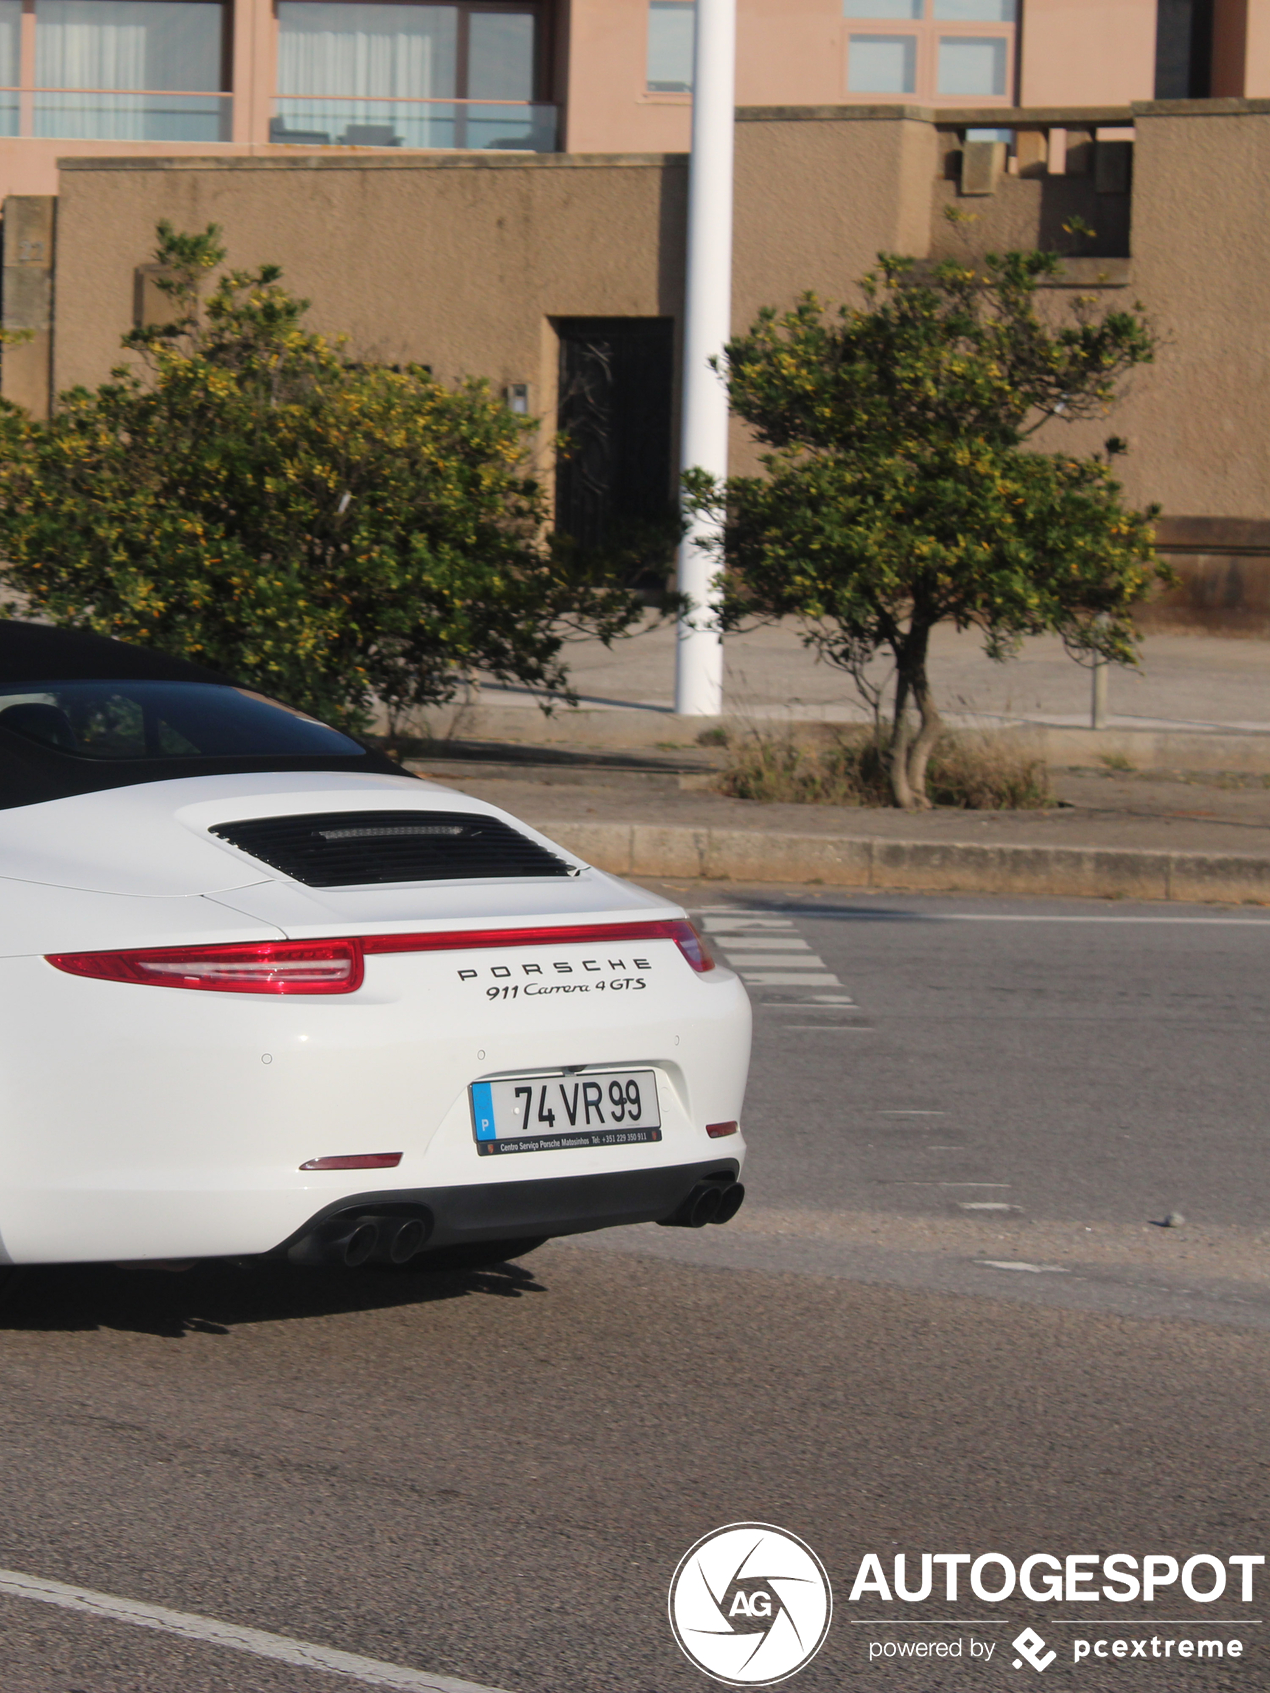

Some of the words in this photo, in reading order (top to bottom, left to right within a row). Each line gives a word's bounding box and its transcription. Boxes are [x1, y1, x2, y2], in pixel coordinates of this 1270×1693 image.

[457, 958, 652, 981] PORSCHE
[486, 985, 519, 1001] 911
[524, 982, 590, 996] Carrera
[595, 980, 606, 991] 4
[610, 978, 647, 991] GTS
[482, 1119, 490, 1131] P
[500, 1143, 518, 1151] Centro
[519, 1141, 539, 1150] Serviço
[540, 1140, 560, 1148] Porsche
[561, 1137, 589, 1147] Matosinhos
[602, 1134, 615, 1143] +351
[616, 1133, 627, 1142] 229
[627, 1133, 637, 1141] 350
[637, 1132, 647, 1140] 911
